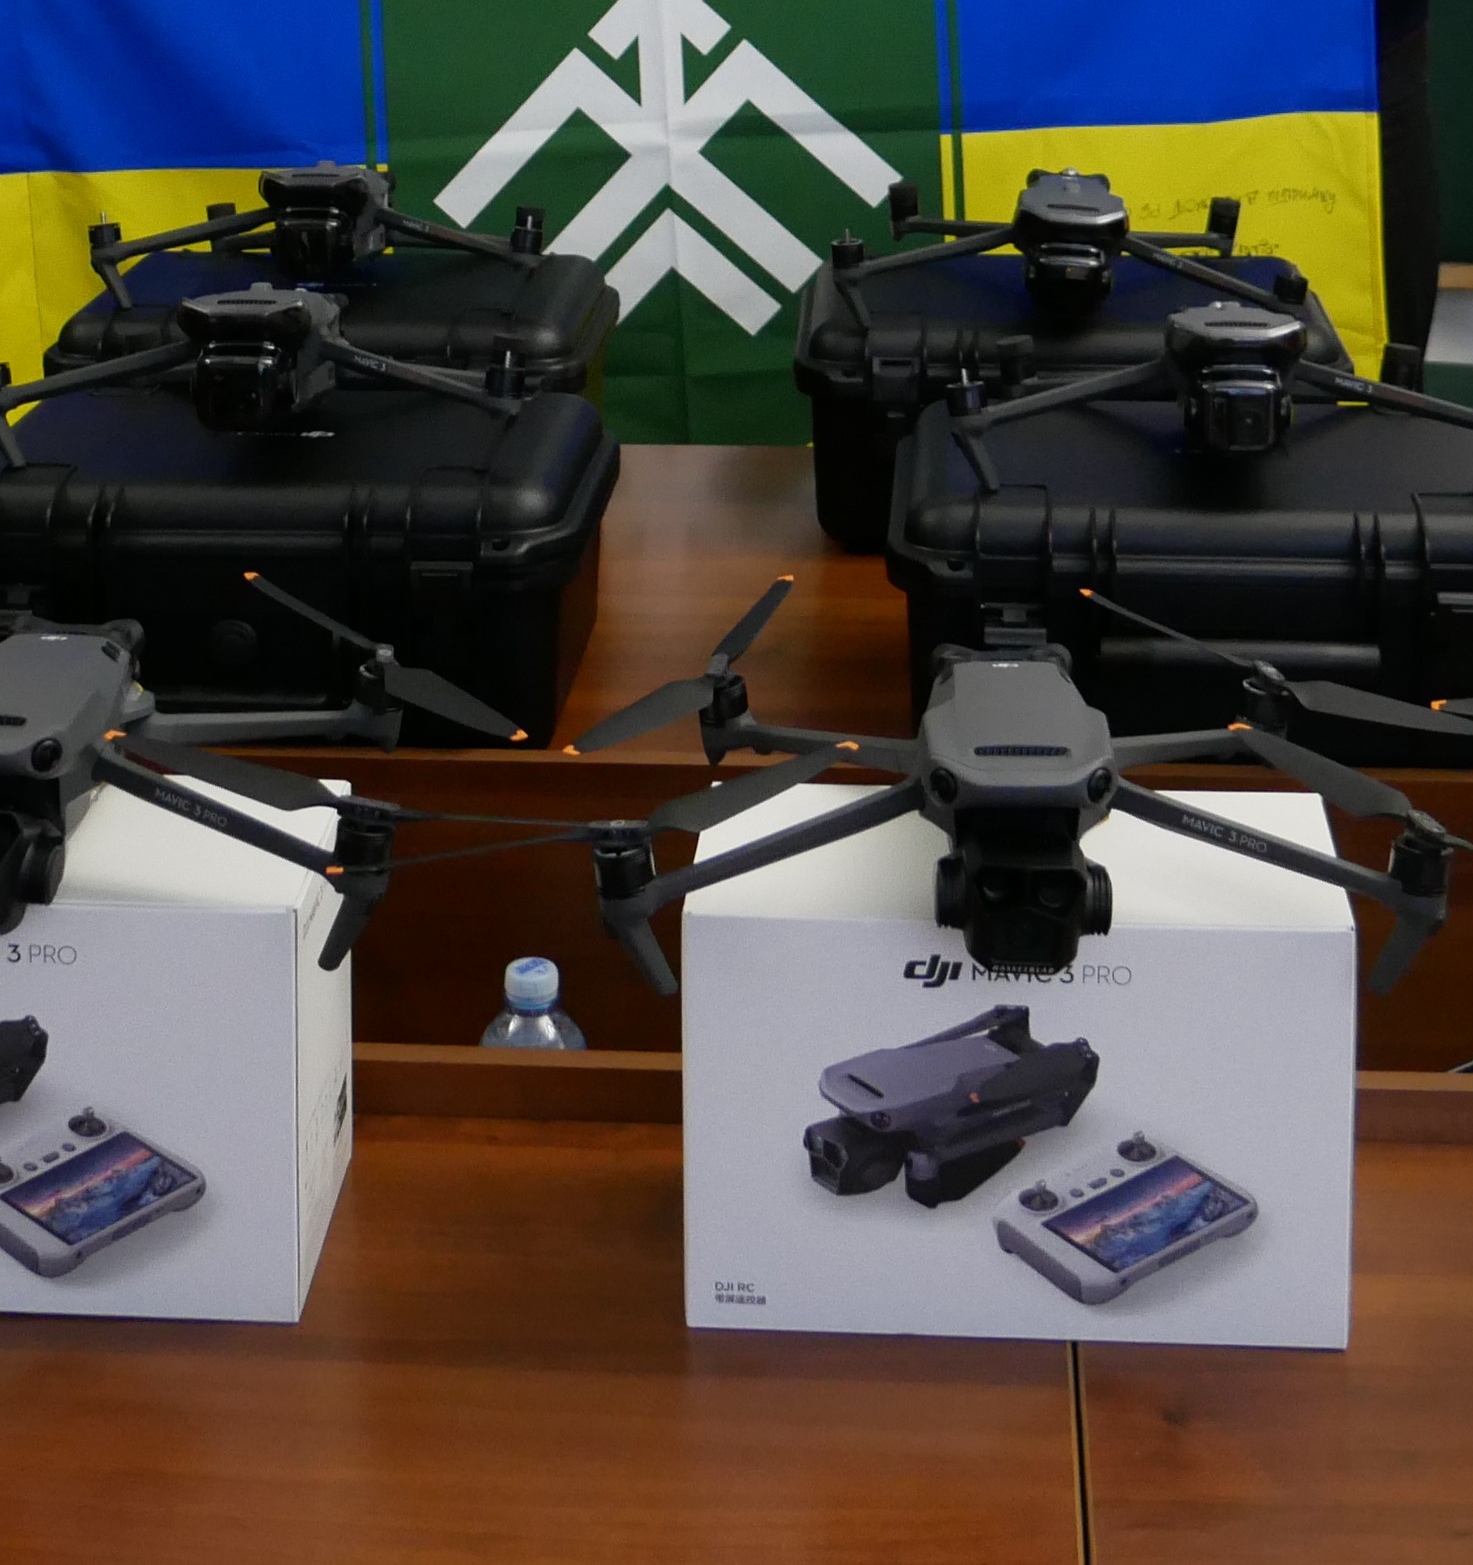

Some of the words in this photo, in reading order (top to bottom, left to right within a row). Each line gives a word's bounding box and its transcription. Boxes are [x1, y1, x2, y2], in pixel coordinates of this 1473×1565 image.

[155, 786, 191, 811] MAVIC
[202, 809, 228, 827] PRO
[1182, 814, 1224, 838] MAVIC
[1239, 834, 1268, 853] PRO
[7, 943, 21, 963] 3
[29, 944, 78, 965] PRO
[1082, 965, 1132, 985] PRO
[715, 1281, 734, 1292] DJI
[737, 1282, 755, 1293] RC
